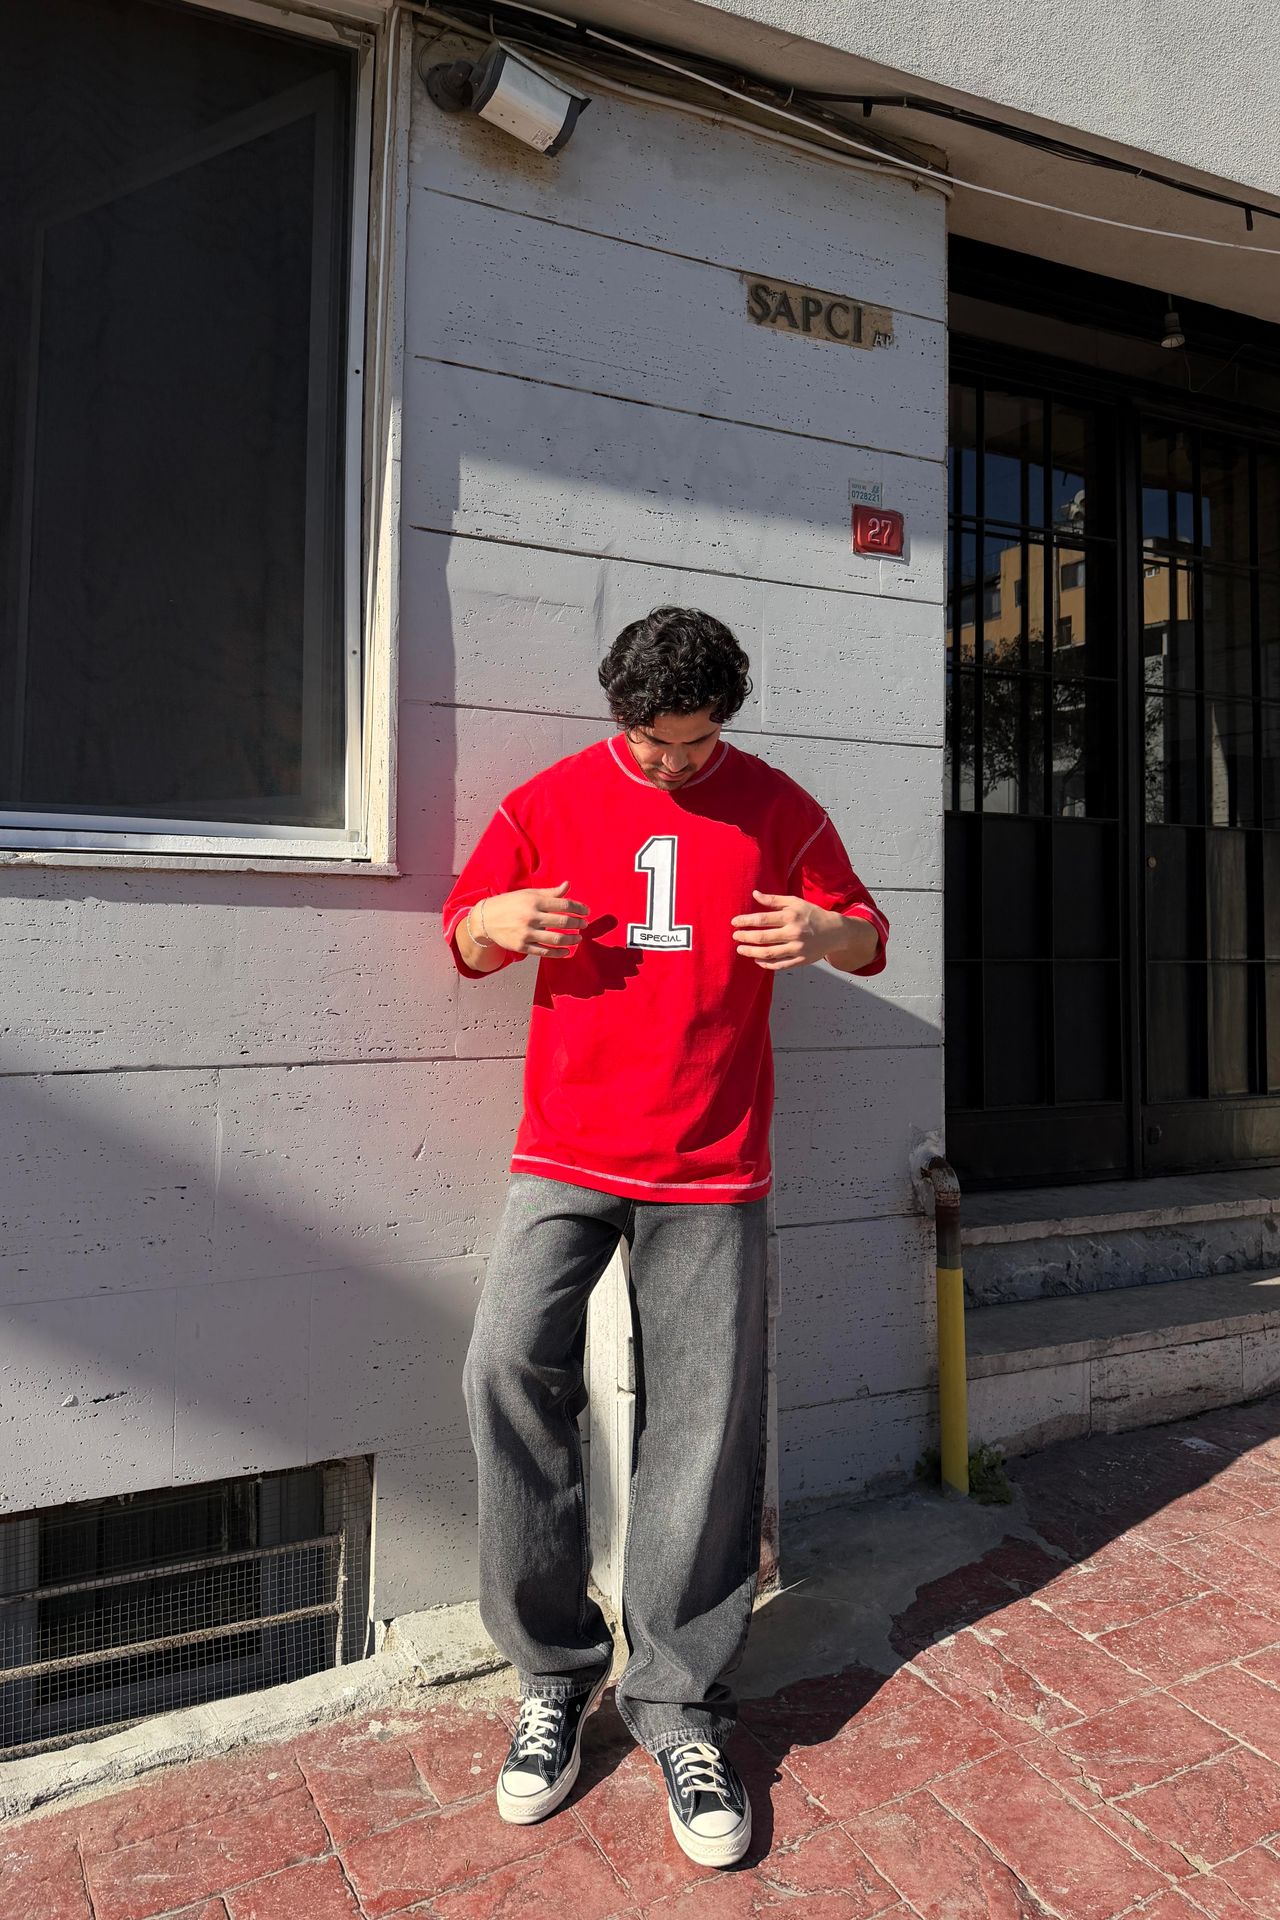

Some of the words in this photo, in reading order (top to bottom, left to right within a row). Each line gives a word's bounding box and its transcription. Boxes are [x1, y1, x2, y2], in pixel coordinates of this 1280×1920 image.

[851, 490, 880, 502] 0728221
[867, 518, 891, 545] 27
[626, 836, 692, 951] 1
[640, 933, 682, 942] SPECIAL
